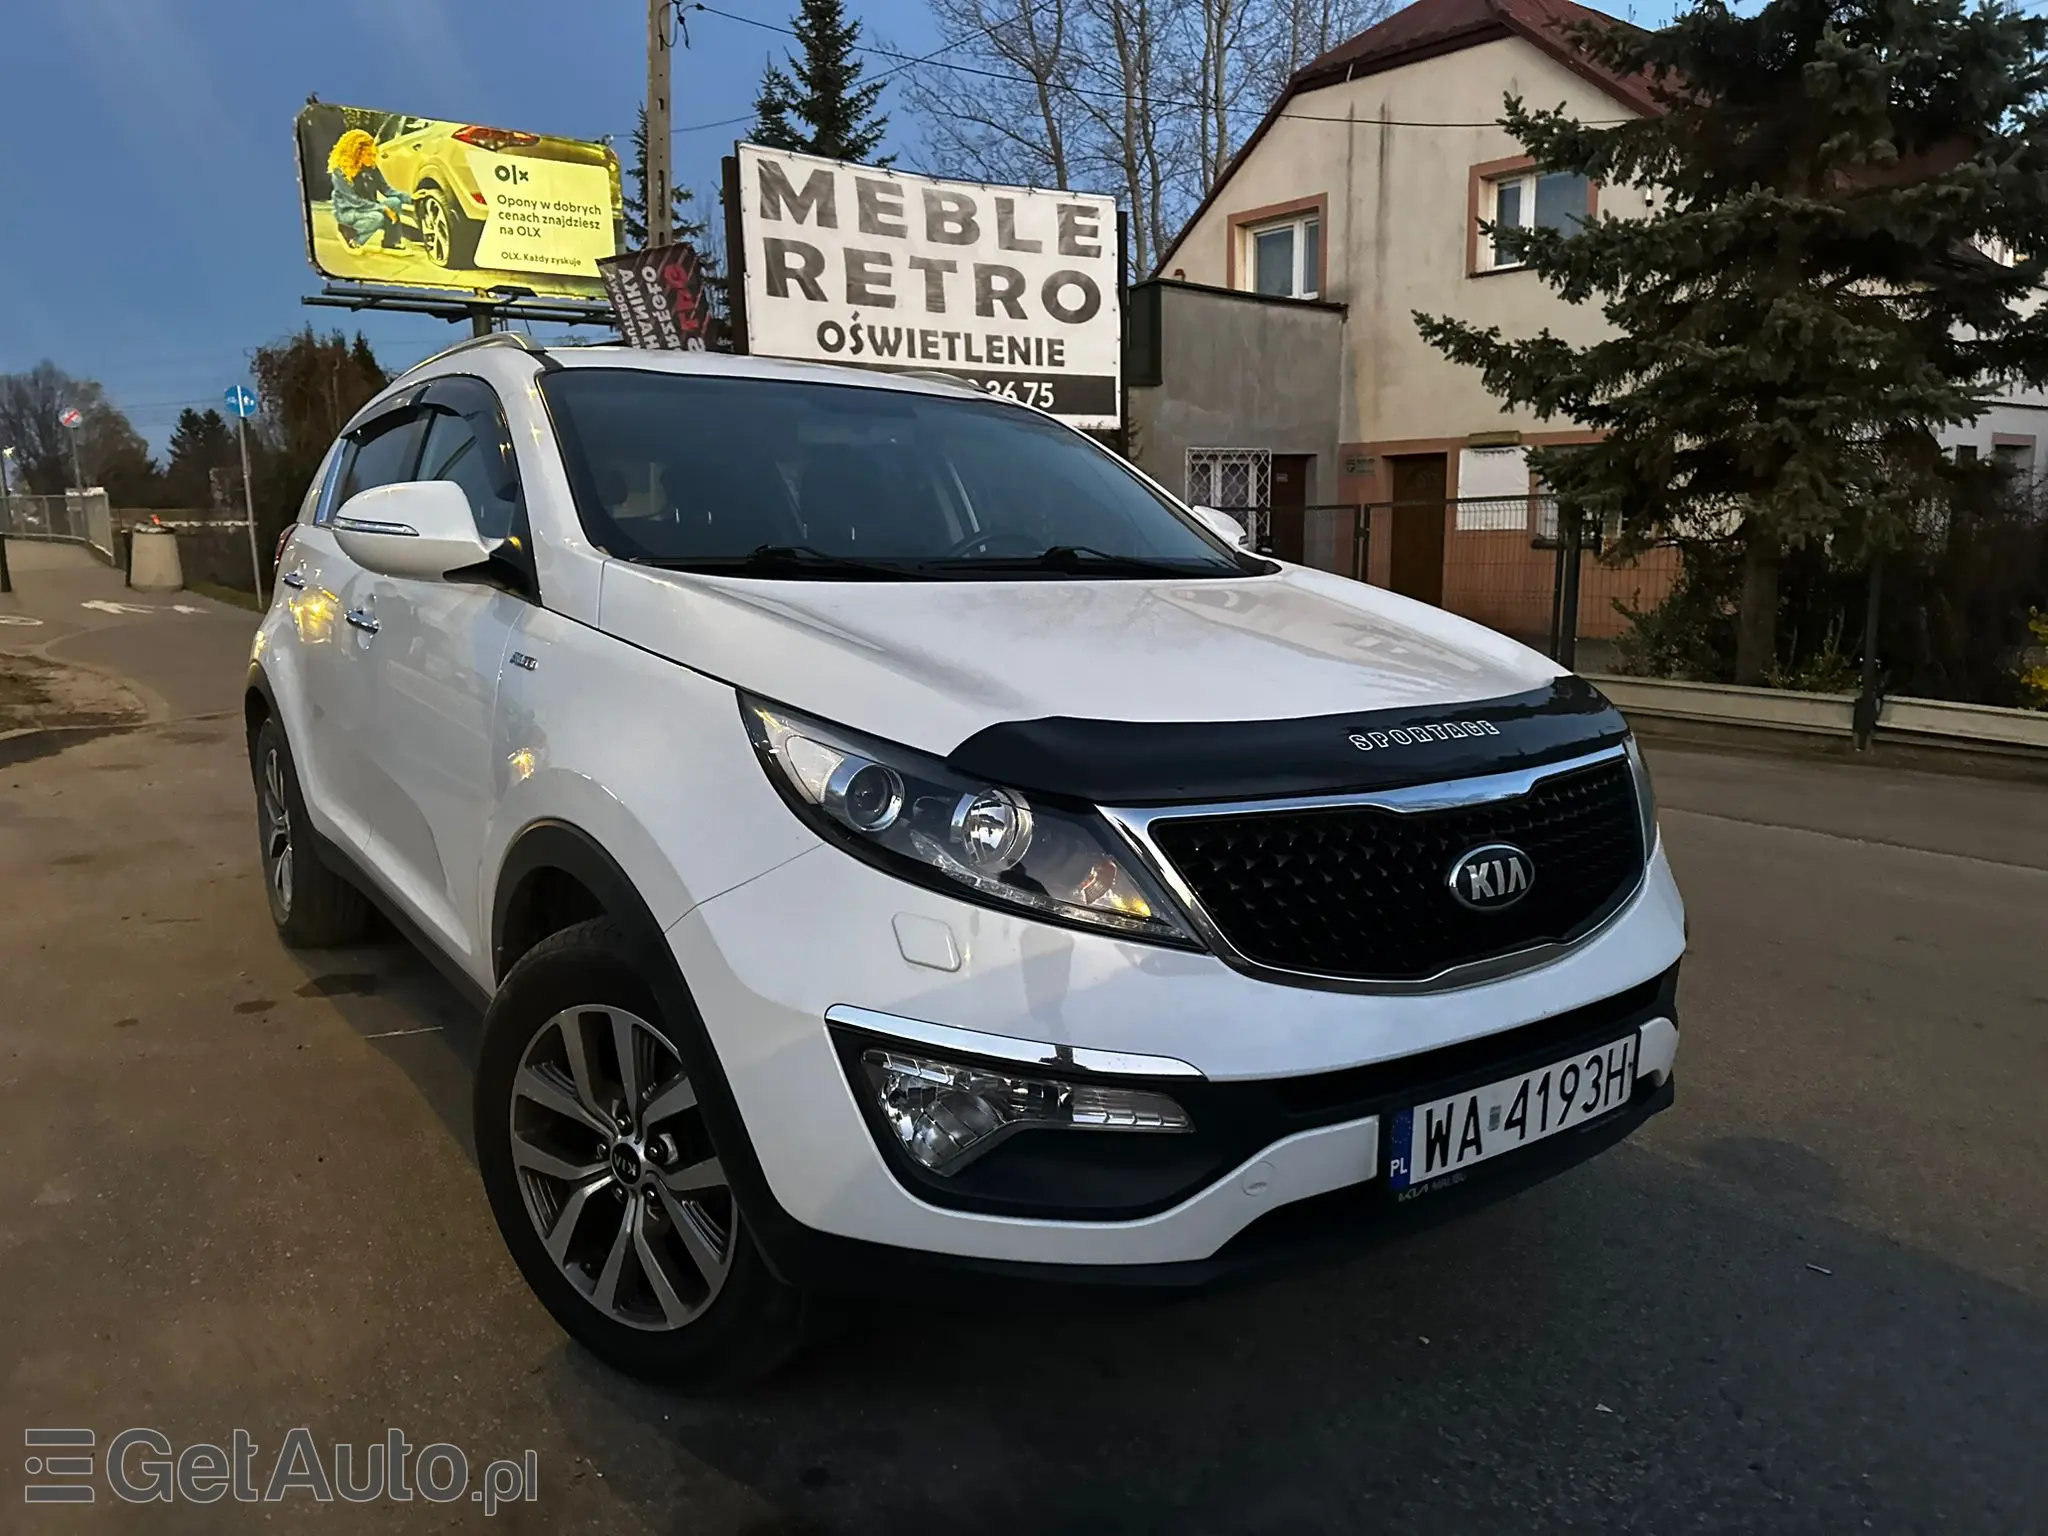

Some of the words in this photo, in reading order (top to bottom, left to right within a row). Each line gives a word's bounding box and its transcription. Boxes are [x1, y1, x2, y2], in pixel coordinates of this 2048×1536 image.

[497, 194, 538, 210] Opony
[540, 200, 551, 210] w
[553, 200, 602, 216] dobrych
[498, 211, 540, 223] cenach
[542, 215, 601, 230] znajdziesz
[757, 158, 1102, 258] MEBLE
[500, 226, 514, 235] na
[517, 226, 541, 238] OLX
[501, 251, 522, 260] OLX.
[523, 253, 549, 265] Każdy
[551, 257, 582, 267] zyskuje
[763, 236, 1101, 324] RETRO
[816, 310, 1065, 367] OŚWIETLENIE
[1349, 720, 1500, 751] SPORTAGE
[1464, 857, 1527, 900] KIA
[1425, 1096, 1483, 1173] WA
[1504, 1043, 1629, 1140] 4193H
[1390, 1157, 1407, 1178] PL
